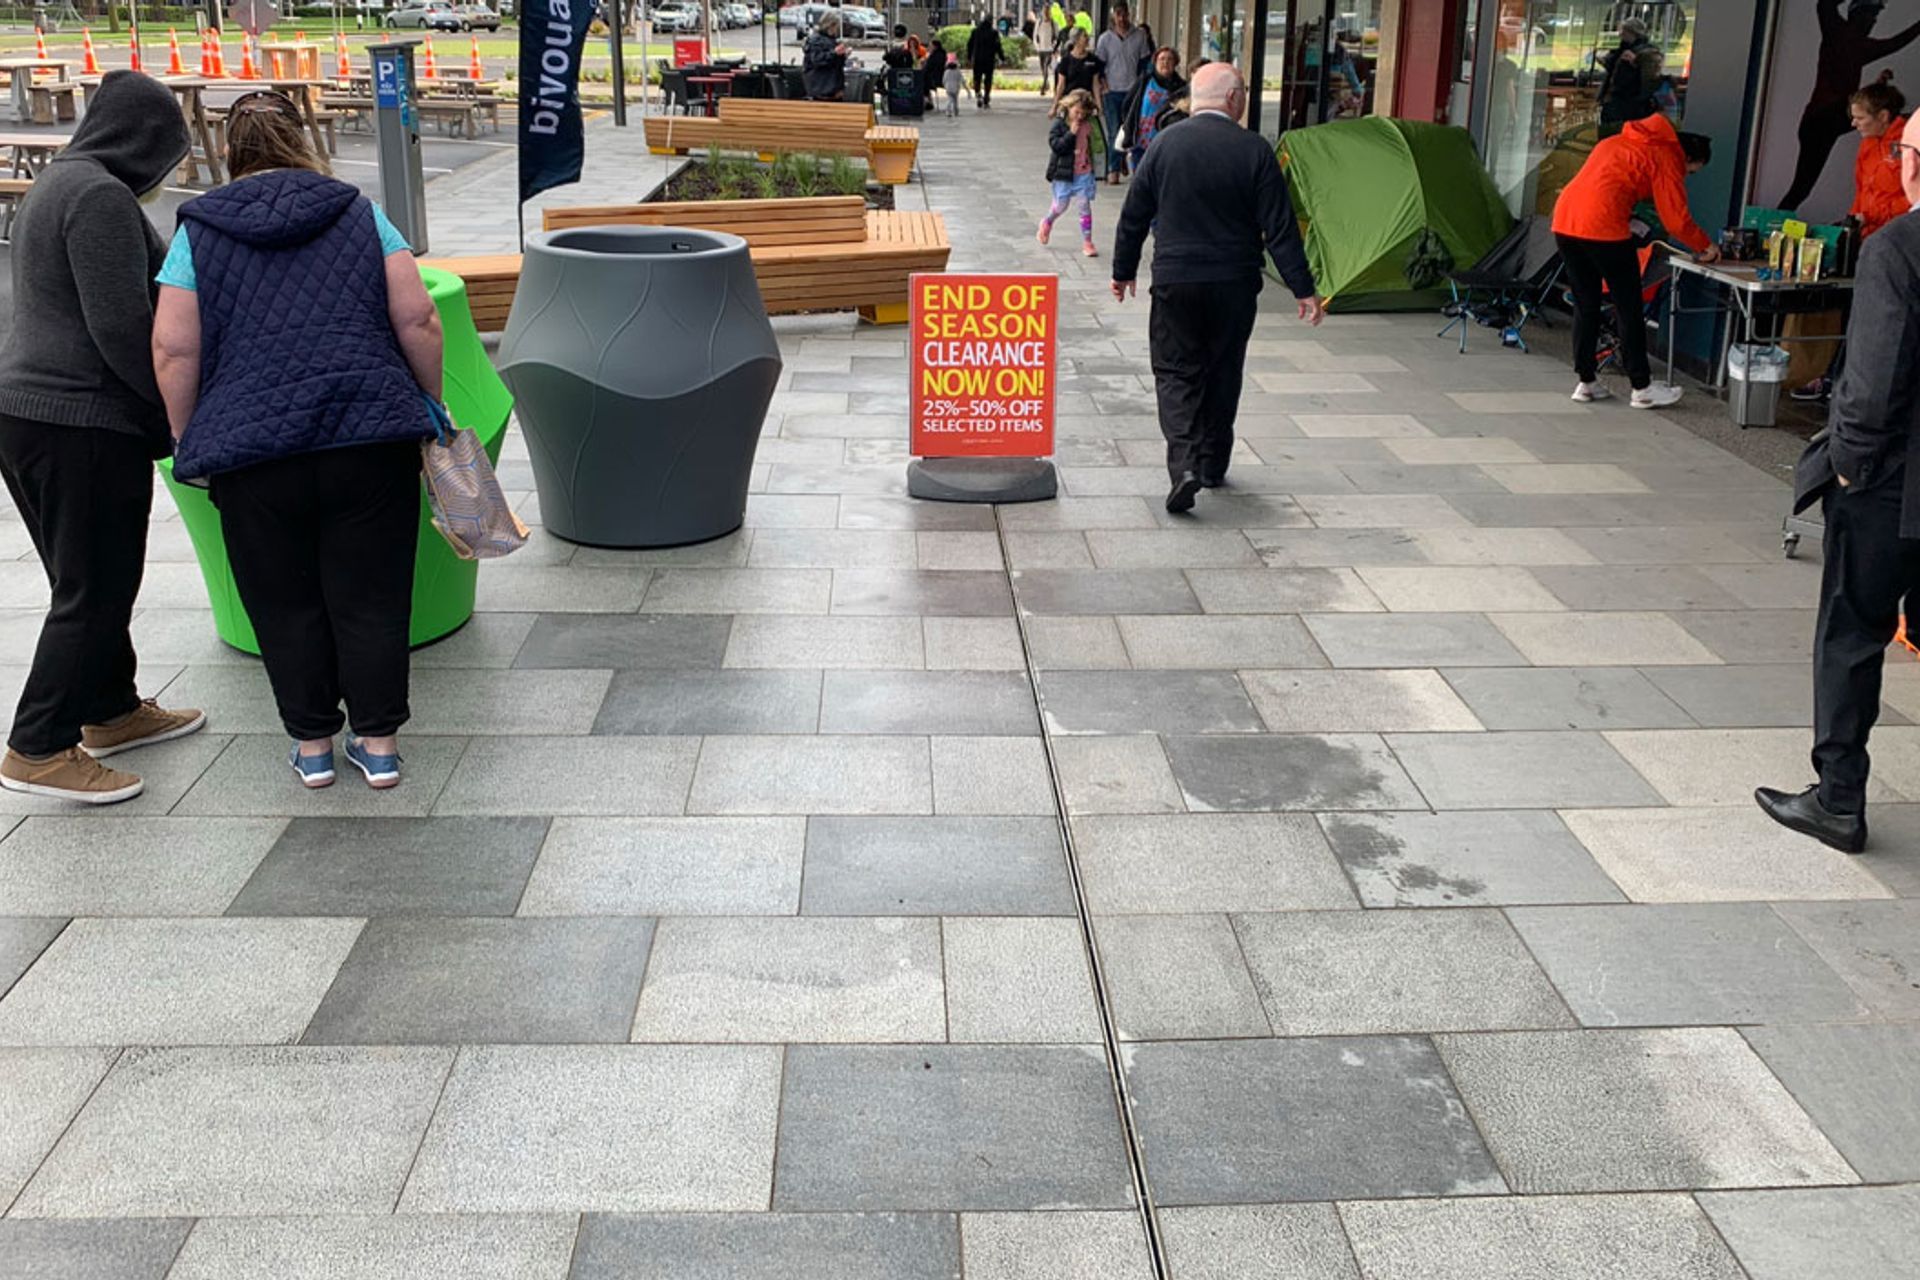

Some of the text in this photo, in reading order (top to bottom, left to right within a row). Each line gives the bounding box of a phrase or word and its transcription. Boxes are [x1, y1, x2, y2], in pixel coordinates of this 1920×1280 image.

[378, 61, 394, 81] P
[923, 284, 1047, 311] END OF
[923, 313, 1046, 338] SEASON
[923, 341, 1045, 367] CLEARANCE
[923, 369, 1044, 396] NOW ON!
[1009, 400, 1043, 416] OFF
[923, 419, 1043, 432] SELECTED ITEMS
